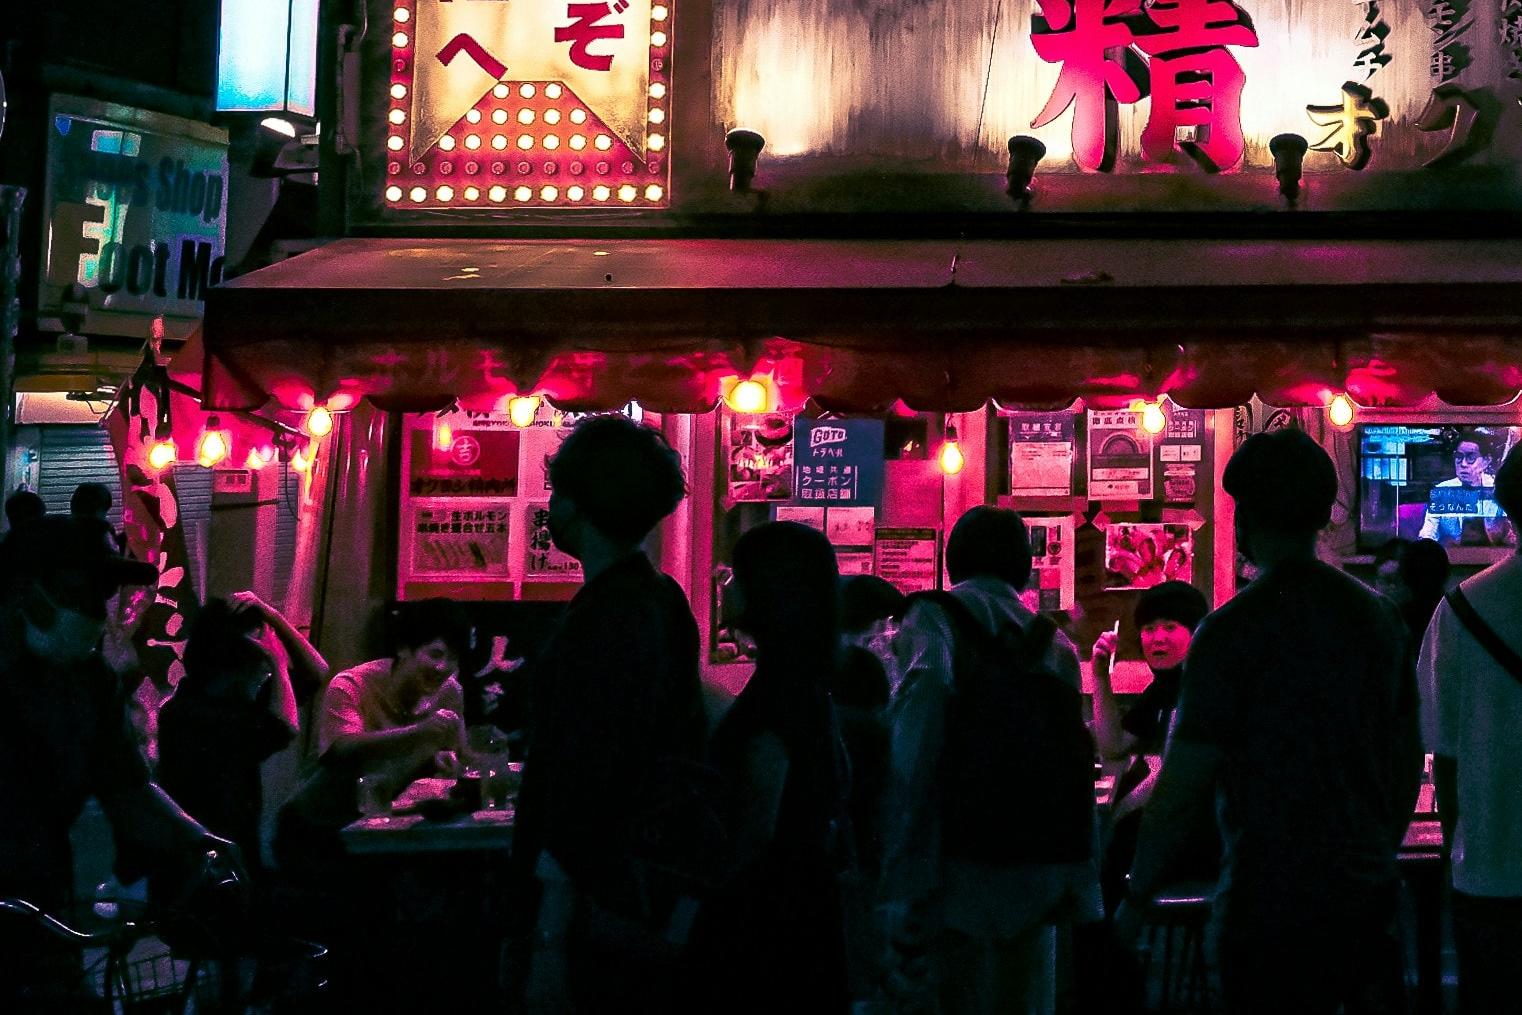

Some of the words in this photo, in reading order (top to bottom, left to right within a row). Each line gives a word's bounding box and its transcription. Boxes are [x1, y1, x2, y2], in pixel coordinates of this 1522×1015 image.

[156, 157, 223, 223] Shop
[802, 475, 852, 486] クーポン
